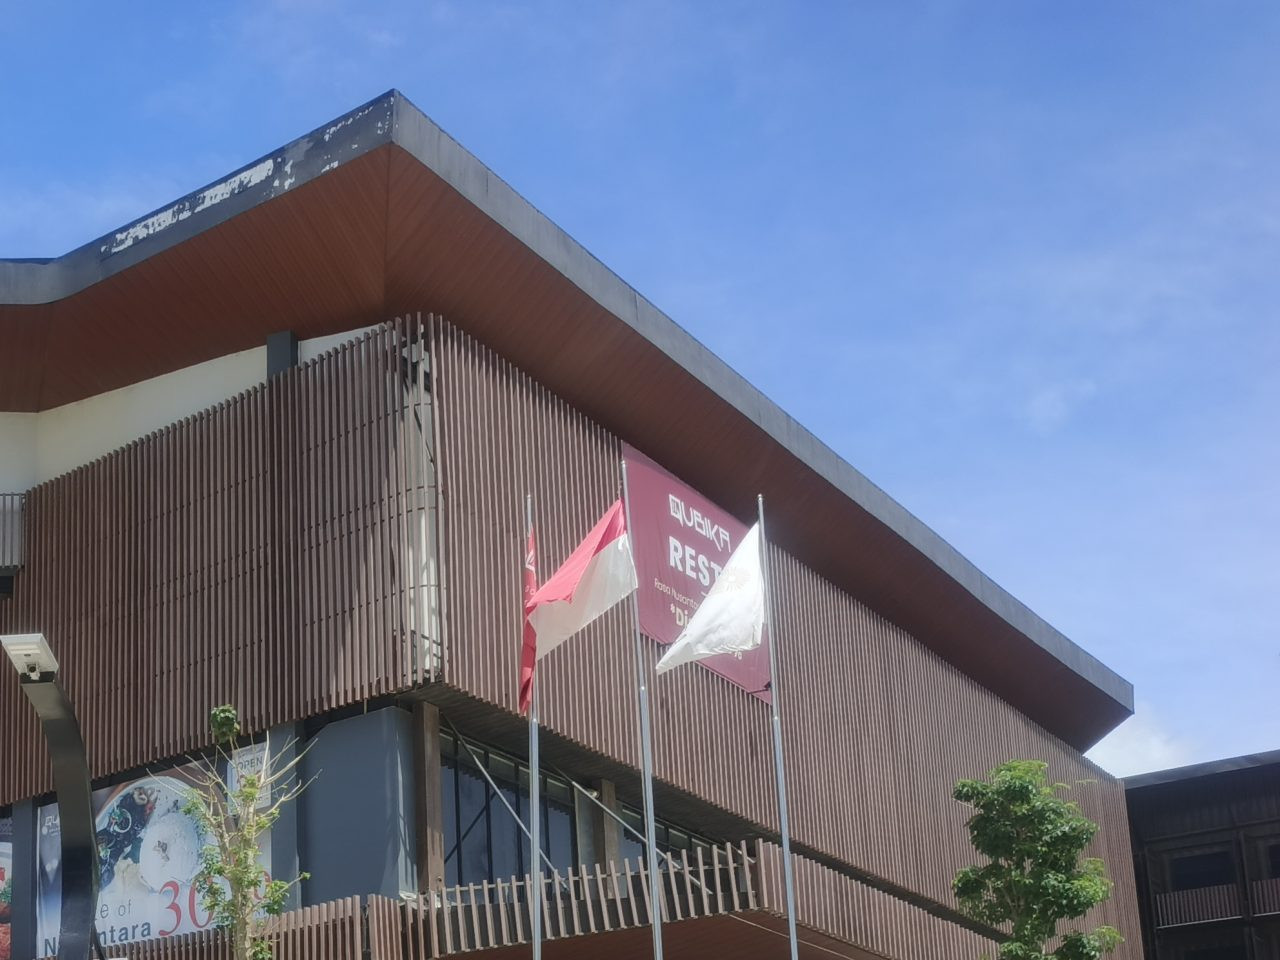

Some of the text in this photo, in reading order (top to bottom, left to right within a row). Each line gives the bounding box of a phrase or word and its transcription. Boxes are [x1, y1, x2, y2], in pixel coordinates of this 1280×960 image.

[669, 494, 731, 553] QUBIKA
[669, 535, 723, 587] REST
[671, 586, 698, 609] Nusanta
[117, 899, 132, 917] of
